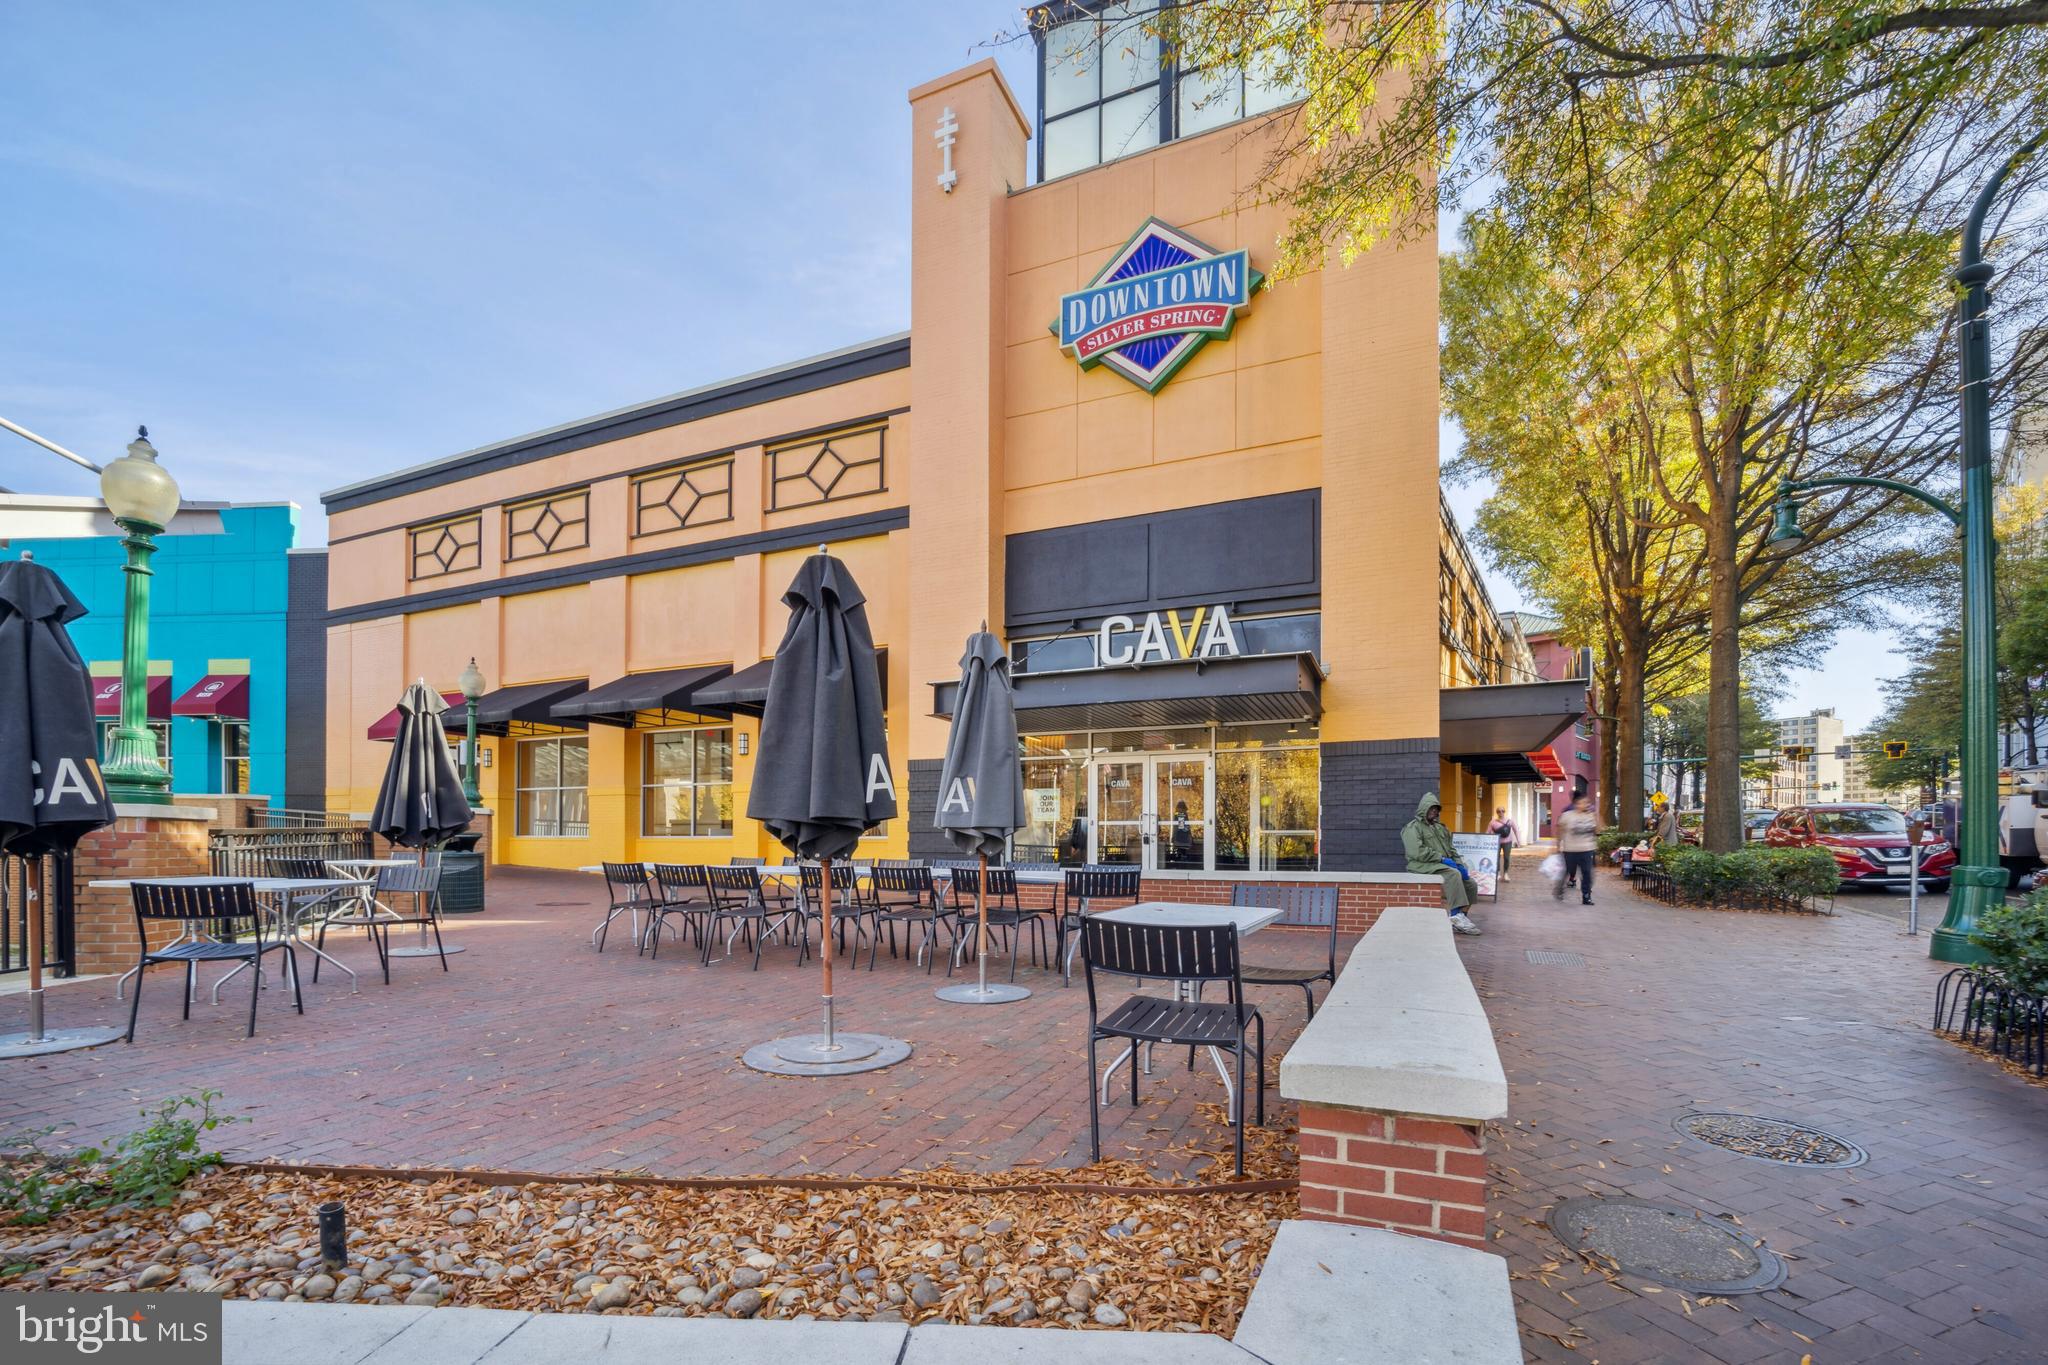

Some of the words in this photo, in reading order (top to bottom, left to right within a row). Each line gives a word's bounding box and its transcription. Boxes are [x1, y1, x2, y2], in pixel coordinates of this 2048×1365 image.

[1070, 260, 1237, 335] DOWNTOWN
[1086, 319, 1146, 351] SILVER
[1150, 309, 1216, 329] SPRING
[1100, 605, 1240, 665] CAVA
[1111, 780, 1131, 788] CAVA
[1172, 778, 1193, 786] CAVA
